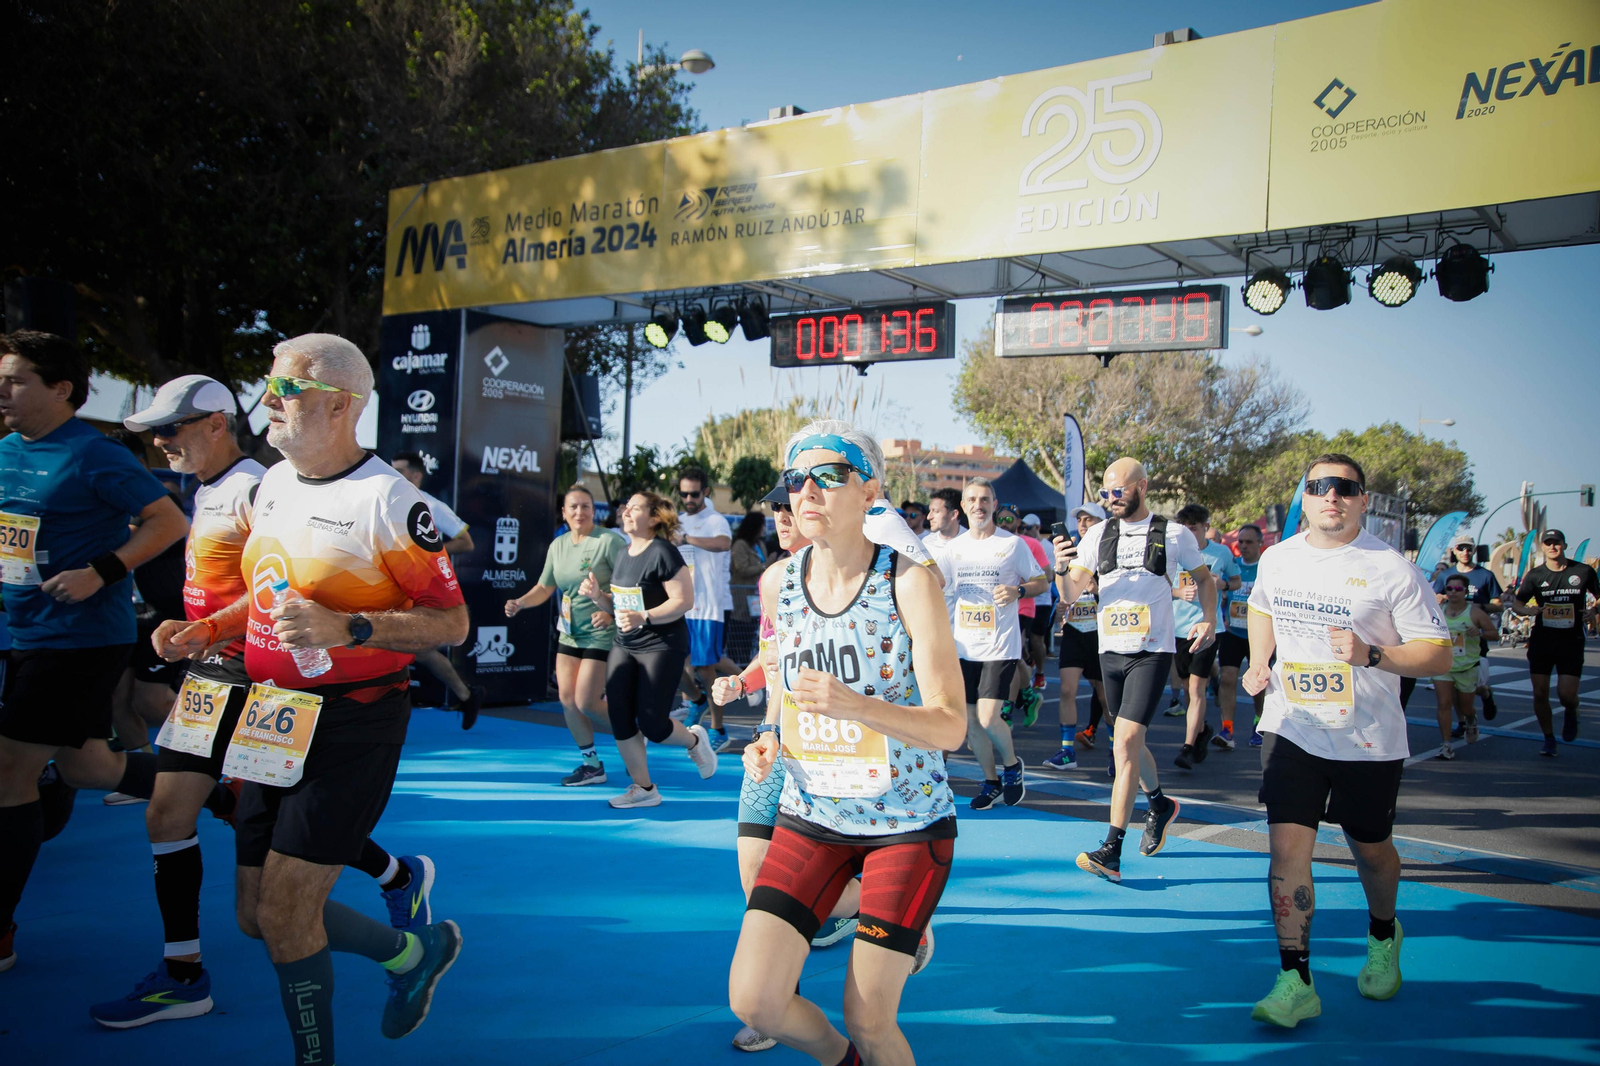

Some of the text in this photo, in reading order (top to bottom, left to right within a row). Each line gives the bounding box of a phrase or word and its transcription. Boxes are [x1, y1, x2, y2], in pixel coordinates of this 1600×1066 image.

[1467, 104, 1496, 119] 2020
[1018, 69, 1164, 197] 25
[1311, 110, 1427, 139] COOPERACIÓN
[1310, 136, 1348, 153] 2005
[505, 193, 659, 233] Medio Maratón
[1015, 187, 1160, 234] EDICIÓN
[671, 207, 866, 246] RAMÓN RUIZ ANDÚJAR
[502, 220, 657, 264] Almería 2024
[392, 351, 448, 374] cajamar
[482, 387, 504, 399] 2005
[483, 377, 544, 395] COOPERACIÓN
[401, 413, 438, 423] HYUNDAI
[482, 568, 527, 582] ALMERÍA
[492, 580, 516, 589] CIUDAD
[1273, 587, 1352, 606] Medio Maratón
[1071, 605, 1097, 616] 1054
[1273, 596, 1351, 617] Almería 2024
[1547, 608, 1571, 616] 1647
[961, 611, 991, 623] 1746
[1111, 613, 1139, 626] 283
[783, 638, 861, 691] COMO
[1287, 672, 1345, 692] 1593
[185, 690, 214, 715] 595
[245, 700, 297, 735] 626
[251, 729, 295, 746] FRANCISCO
[797, 712, 863, 744] 886
[802, 741, 857, 753] MARÍA JOSÉ
[894, 778, 909, 793] COMO
[288, 980, 322, 1064] kalenji
